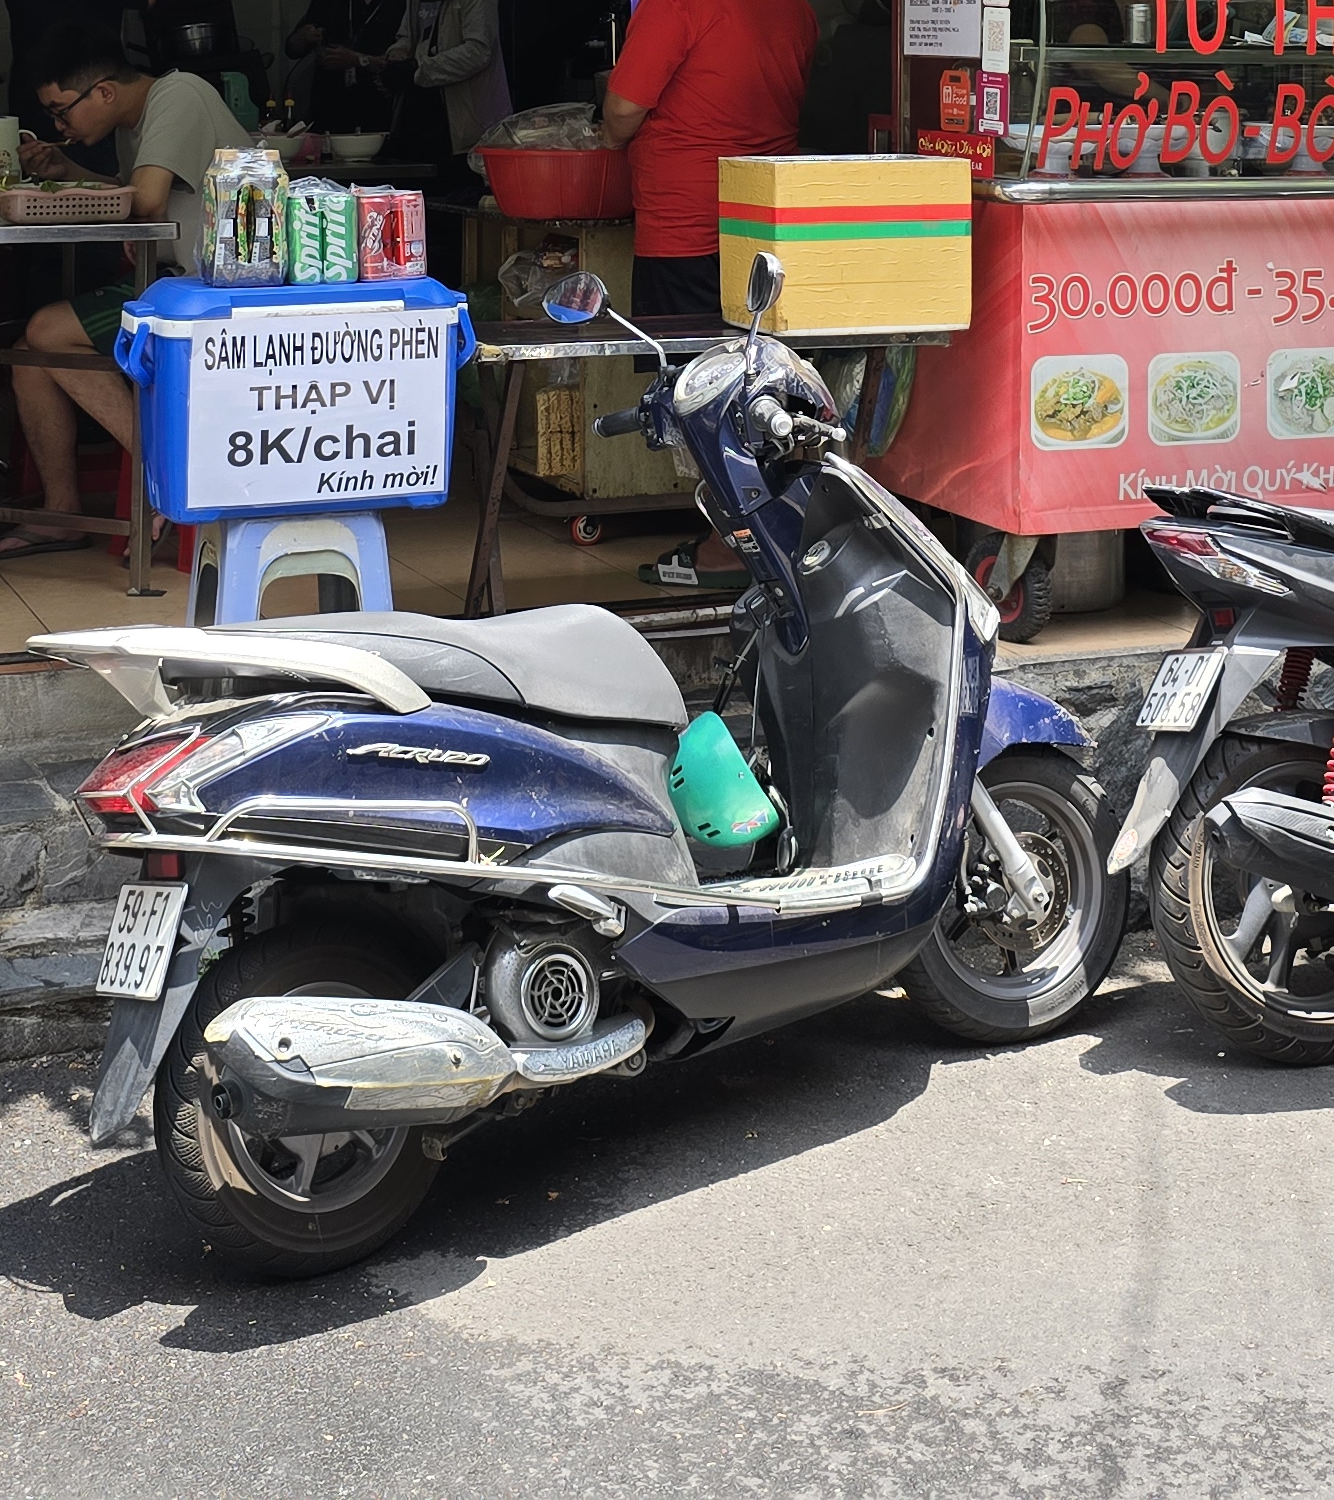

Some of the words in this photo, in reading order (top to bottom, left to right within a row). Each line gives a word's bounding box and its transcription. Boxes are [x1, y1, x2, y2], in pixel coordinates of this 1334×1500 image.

[952, 95, 967, 105] Food
[1036, 71, 1159, 170] PHỞ
[1160, 70, 1240, 165] BÒ
[970, 162, 982, 171] EAR
[1027, 258, 1240, 335] 30.000đ
[204, 328, 246, 370] SÂM
[253, 333, 305, 376] LẠNH
[311, 322, 383, 365] ĐƯỜNG
[389, 319, 439, 361] PHÈN
[249, 380, 352, 415] THẬP
[362, 378, 396, 410] VỊ
[227, 420, 416, 467] 8K/chai
[317, 470, 374, 494] Kính
[382, 464, 438, 489] mời!
[1242, 460, 1297, 498] QUÝ
[1141, 692, 1202, 724] 508.58
[100, 941, 165, 992] 839.97
